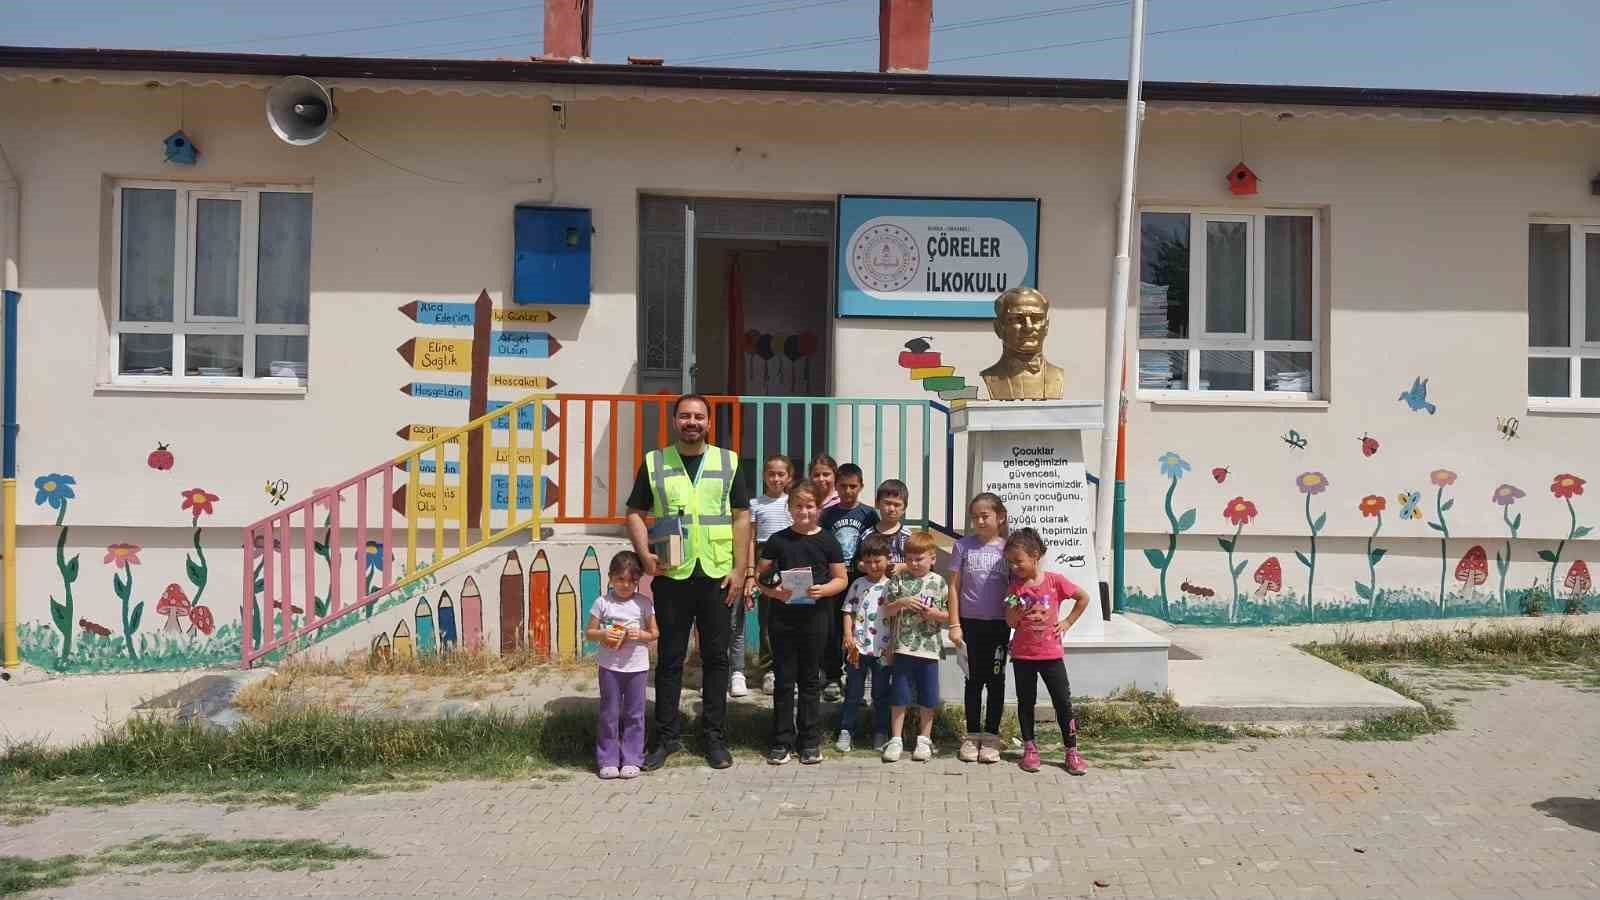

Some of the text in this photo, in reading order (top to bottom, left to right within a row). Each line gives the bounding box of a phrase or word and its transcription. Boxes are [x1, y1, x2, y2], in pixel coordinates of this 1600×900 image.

[927, 232, 1001, 262] ÇÖRELER
[926, 267, 1007, 293] İLKOKULU
[428, 342, 455, 353] Eline
[1012, 446, 1054, 457] Çocuklar
[1003, 458, 1068, 468] geleceğimizin
[1009, 470, 1060, 480] güvencesi,
[986, 480, 1083, 491] yaşama sevincimizdir.
[1034, 491, 1083, 502] çocuğunu,
[1022, 504, 1054, 514] yarının
[1040, 515, 1069, 523] olarak
[1042, 526, 1088, 536] hepimizin
[1041, 537, 1082, 547] örevidir.
